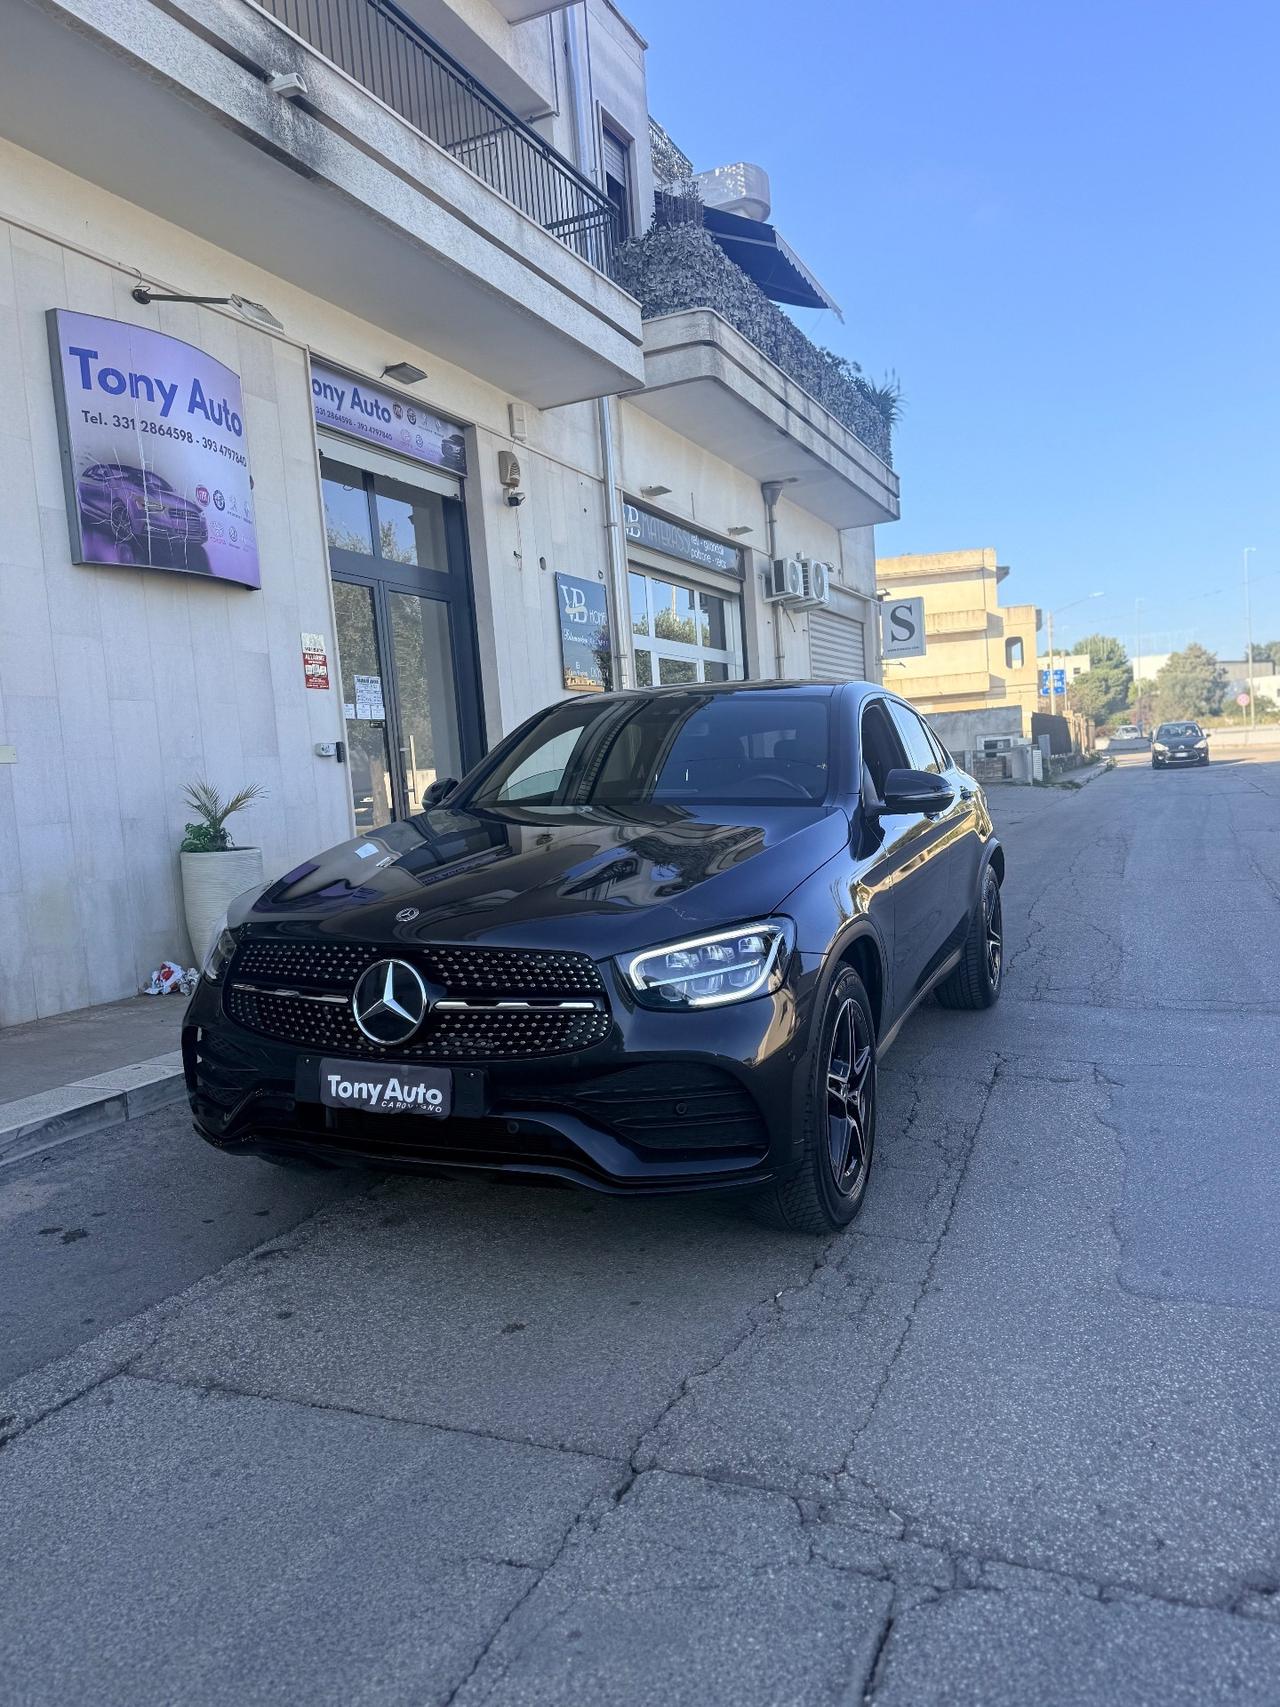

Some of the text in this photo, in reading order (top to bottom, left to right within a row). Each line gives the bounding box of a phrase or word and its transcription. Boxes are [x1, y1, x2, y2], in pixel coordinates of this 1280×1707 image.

[68, 346, 243, 437] Tony Auto
[312, 378, 345, 411] ony
[350, 387, 392, 424] Auto
[81, 410, 108, 426] Tel.
[112, 415, 135, 431] 331
[140, 420, 193, 444] 2864598
[202, 437, 218, 454] 393
[890, 604, 916, 643] S
[327, 1074, 443, 1105] Tony Auto
